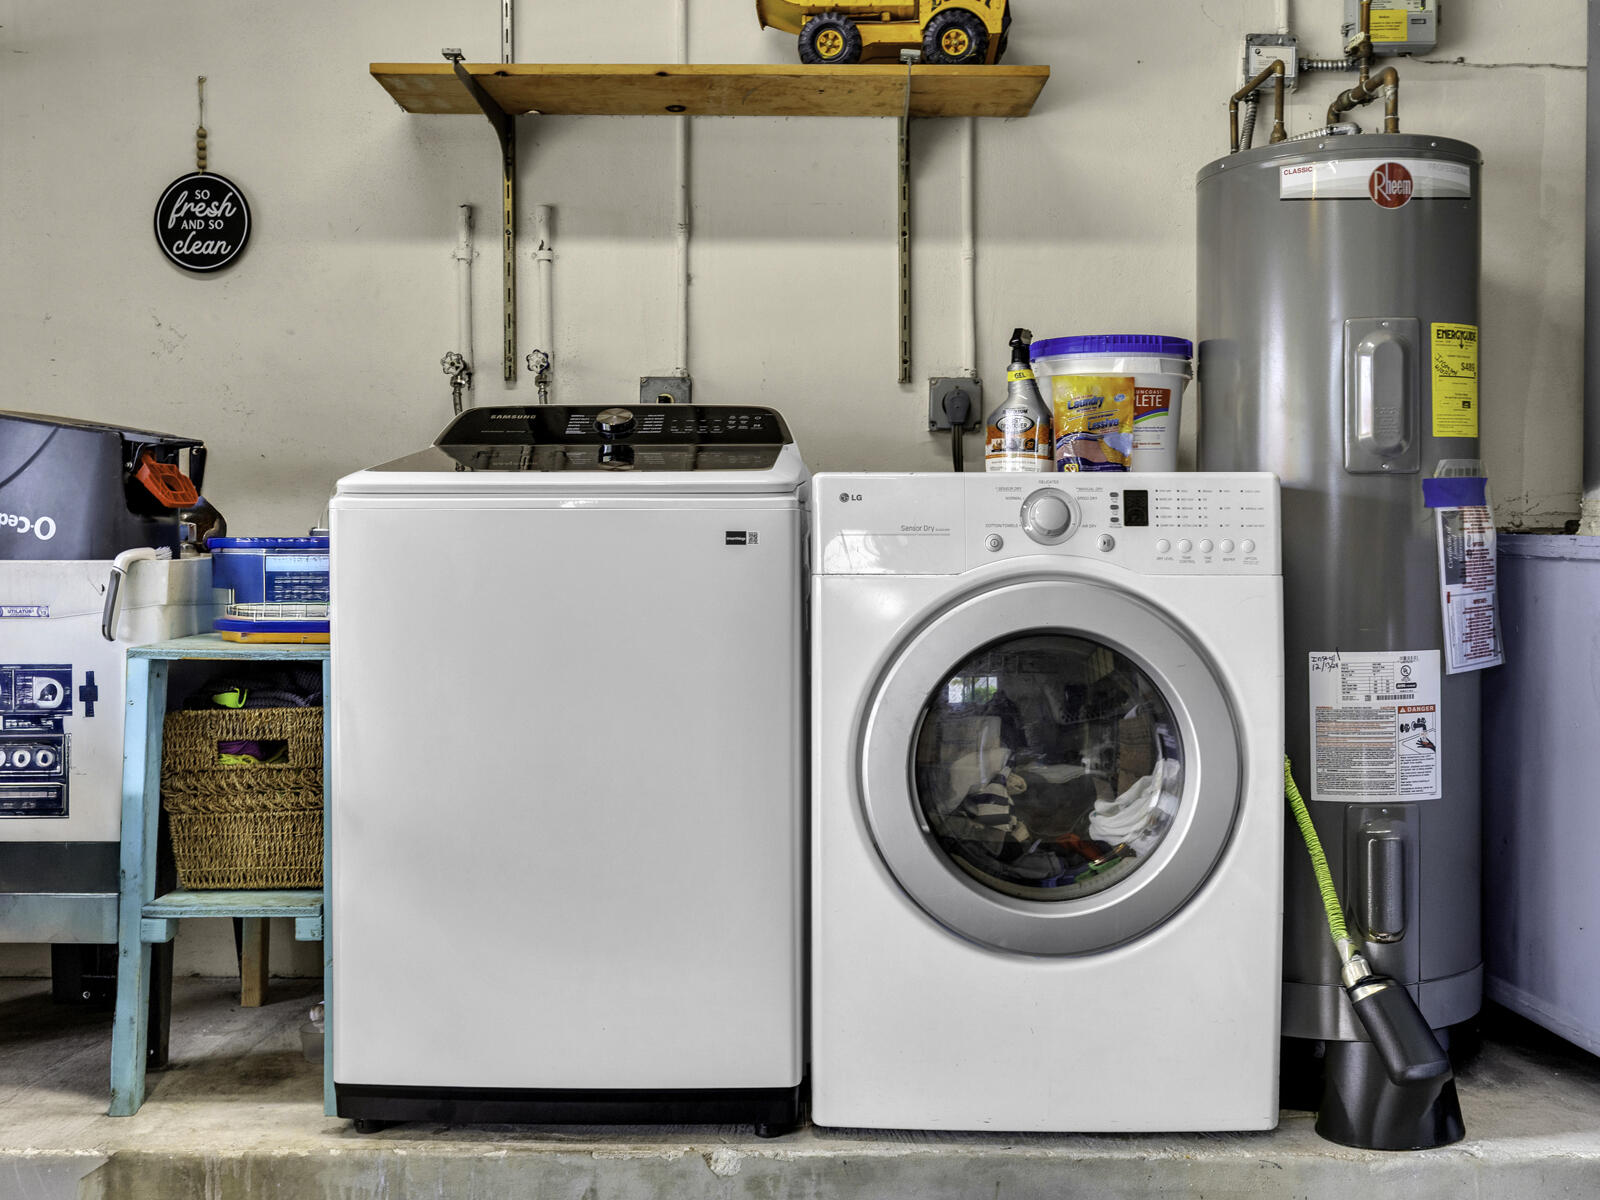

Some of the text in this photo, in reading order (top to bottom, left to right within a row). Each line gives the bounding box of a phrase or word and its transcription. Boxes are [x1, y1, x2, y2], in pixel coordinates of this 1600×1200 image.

[1283, 166, 1313, 176] CLASSIC
[1374, 163, 1411, 201] Rheem
[194, 189, 211, 200] SO
[168, 190, 237, 229] fresh
[181, 219, 224, 230] AND SO
[172, 231, 231, 255] clean
[1067, 396, 1104, 410] Laundry
[1135, 394, 1163, 407] LETE
[900, 524, 922, 532] Sensor
[923, 524, 935, 533] Dry
[1407, 705, 1435, 713] DANGER
